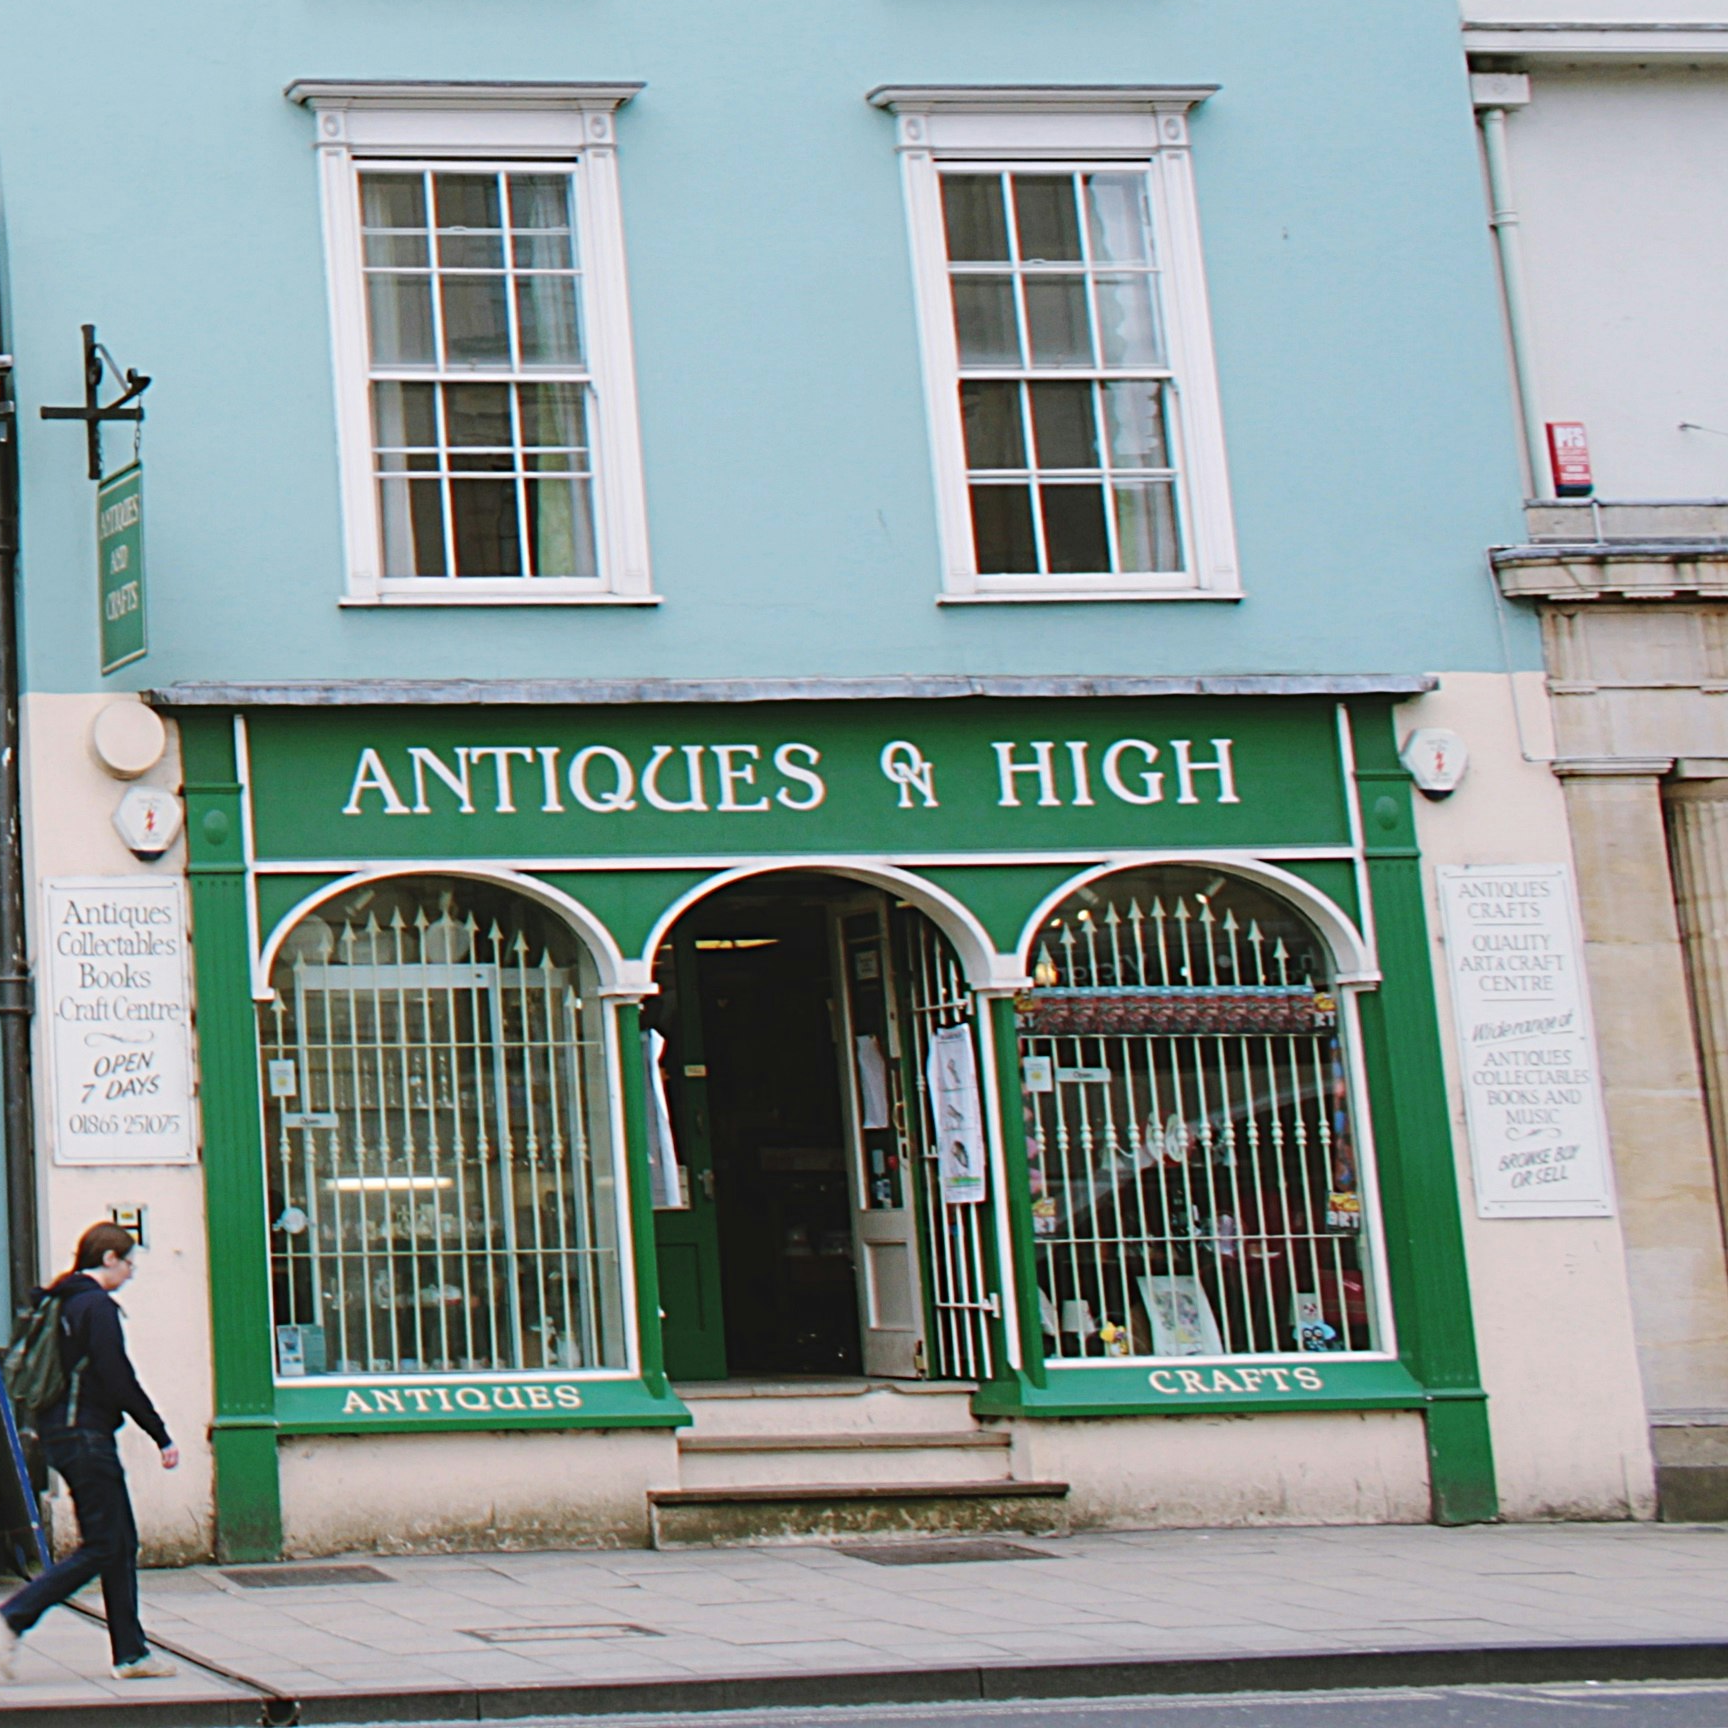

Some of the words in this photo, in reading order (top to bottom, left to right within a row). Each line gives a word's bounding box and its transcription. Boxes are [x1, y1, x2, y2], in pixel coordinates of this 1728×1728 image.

[106, 580, 139, 621] CRAFTS
[343, 742, 826, 815] ANTIQUES
[880, 740, 940, 807] ON
[991, 738, 1241, 806] HIGH
[1458, 881, 1550, 898] ANTIQUES
[63, 899, 172, 929] Antiques
[1468, 902, 1541, 919] CRAFTS
[57, 930, 177, 957] Collectables
[1472, 934, 1552, 952] QUALITY
[78, 962, 152, 989] Books
[1479, 975, 1554, 992] CENTRE
[59, 996, 109, 1021] Craft
[113, 996, 181, 1021] Centre
[94, 1051, 154, 1078] OPEN
[1483, 1050, 1572, 1067] ANTIQUES
[81, 1084, 95, 1104] 7
[105, 1074, 160, 1100] DAYS
[1473, 1069, 1590, 1086] COLLECTABLES
[1488, 1089, 1540, 1105] BOOKS
[1545, 1089, 1582, 1105] AND
[69, 1113, 118, 1134] 01865
[124, 1113, 181, 1134] 251075
[1506, 1109, 1560, 1125] MUSIC
[1499, 1148, 1552, 1171] BROWSE
[1511, 1171, 1533, 1188] OR
[1536, 1165, 1569, 1184] SELL
[1148, 1367, 1324, 1395] CRAFTS
[342, 1384, 583, 1416] ANTIQUES
